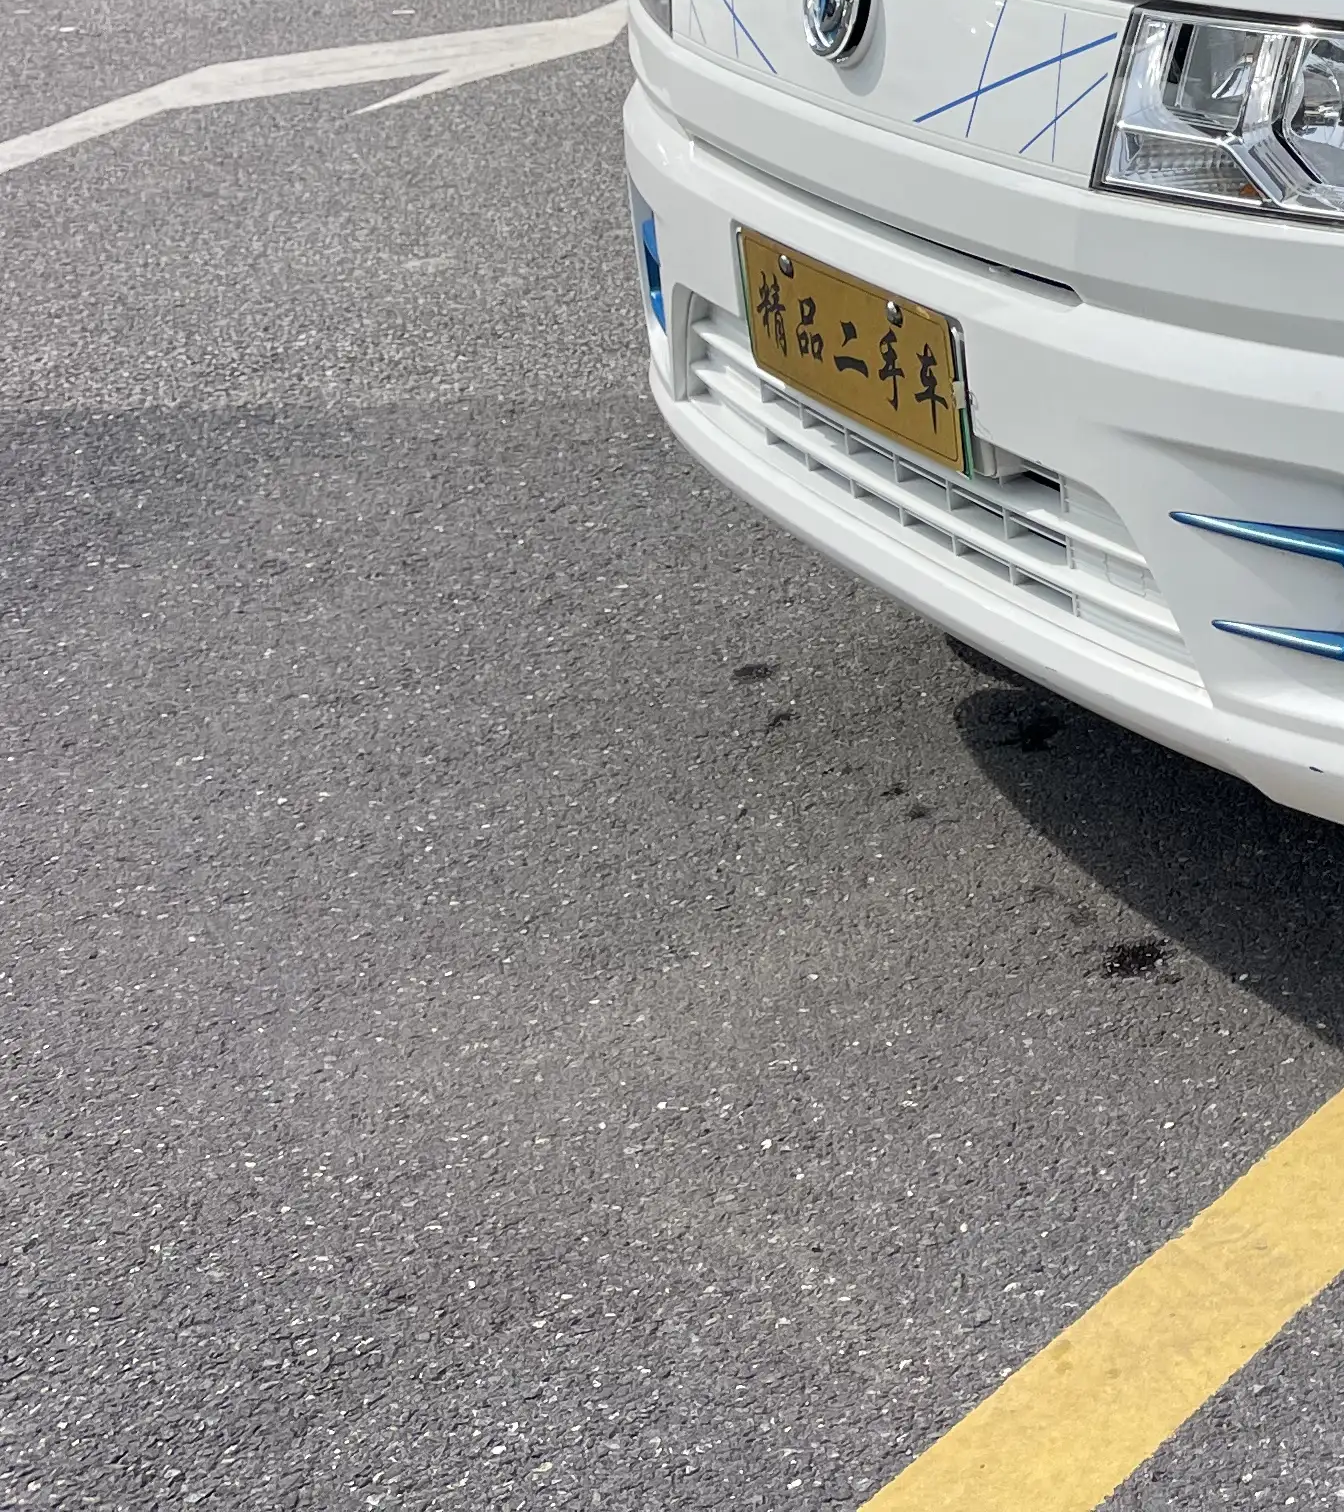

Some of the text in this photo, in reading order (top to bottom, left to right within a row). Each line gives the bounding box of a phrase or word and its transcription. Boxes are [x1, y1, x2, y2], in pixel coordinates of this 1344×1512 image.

[756, 270, 949, 435] 精品二手车
